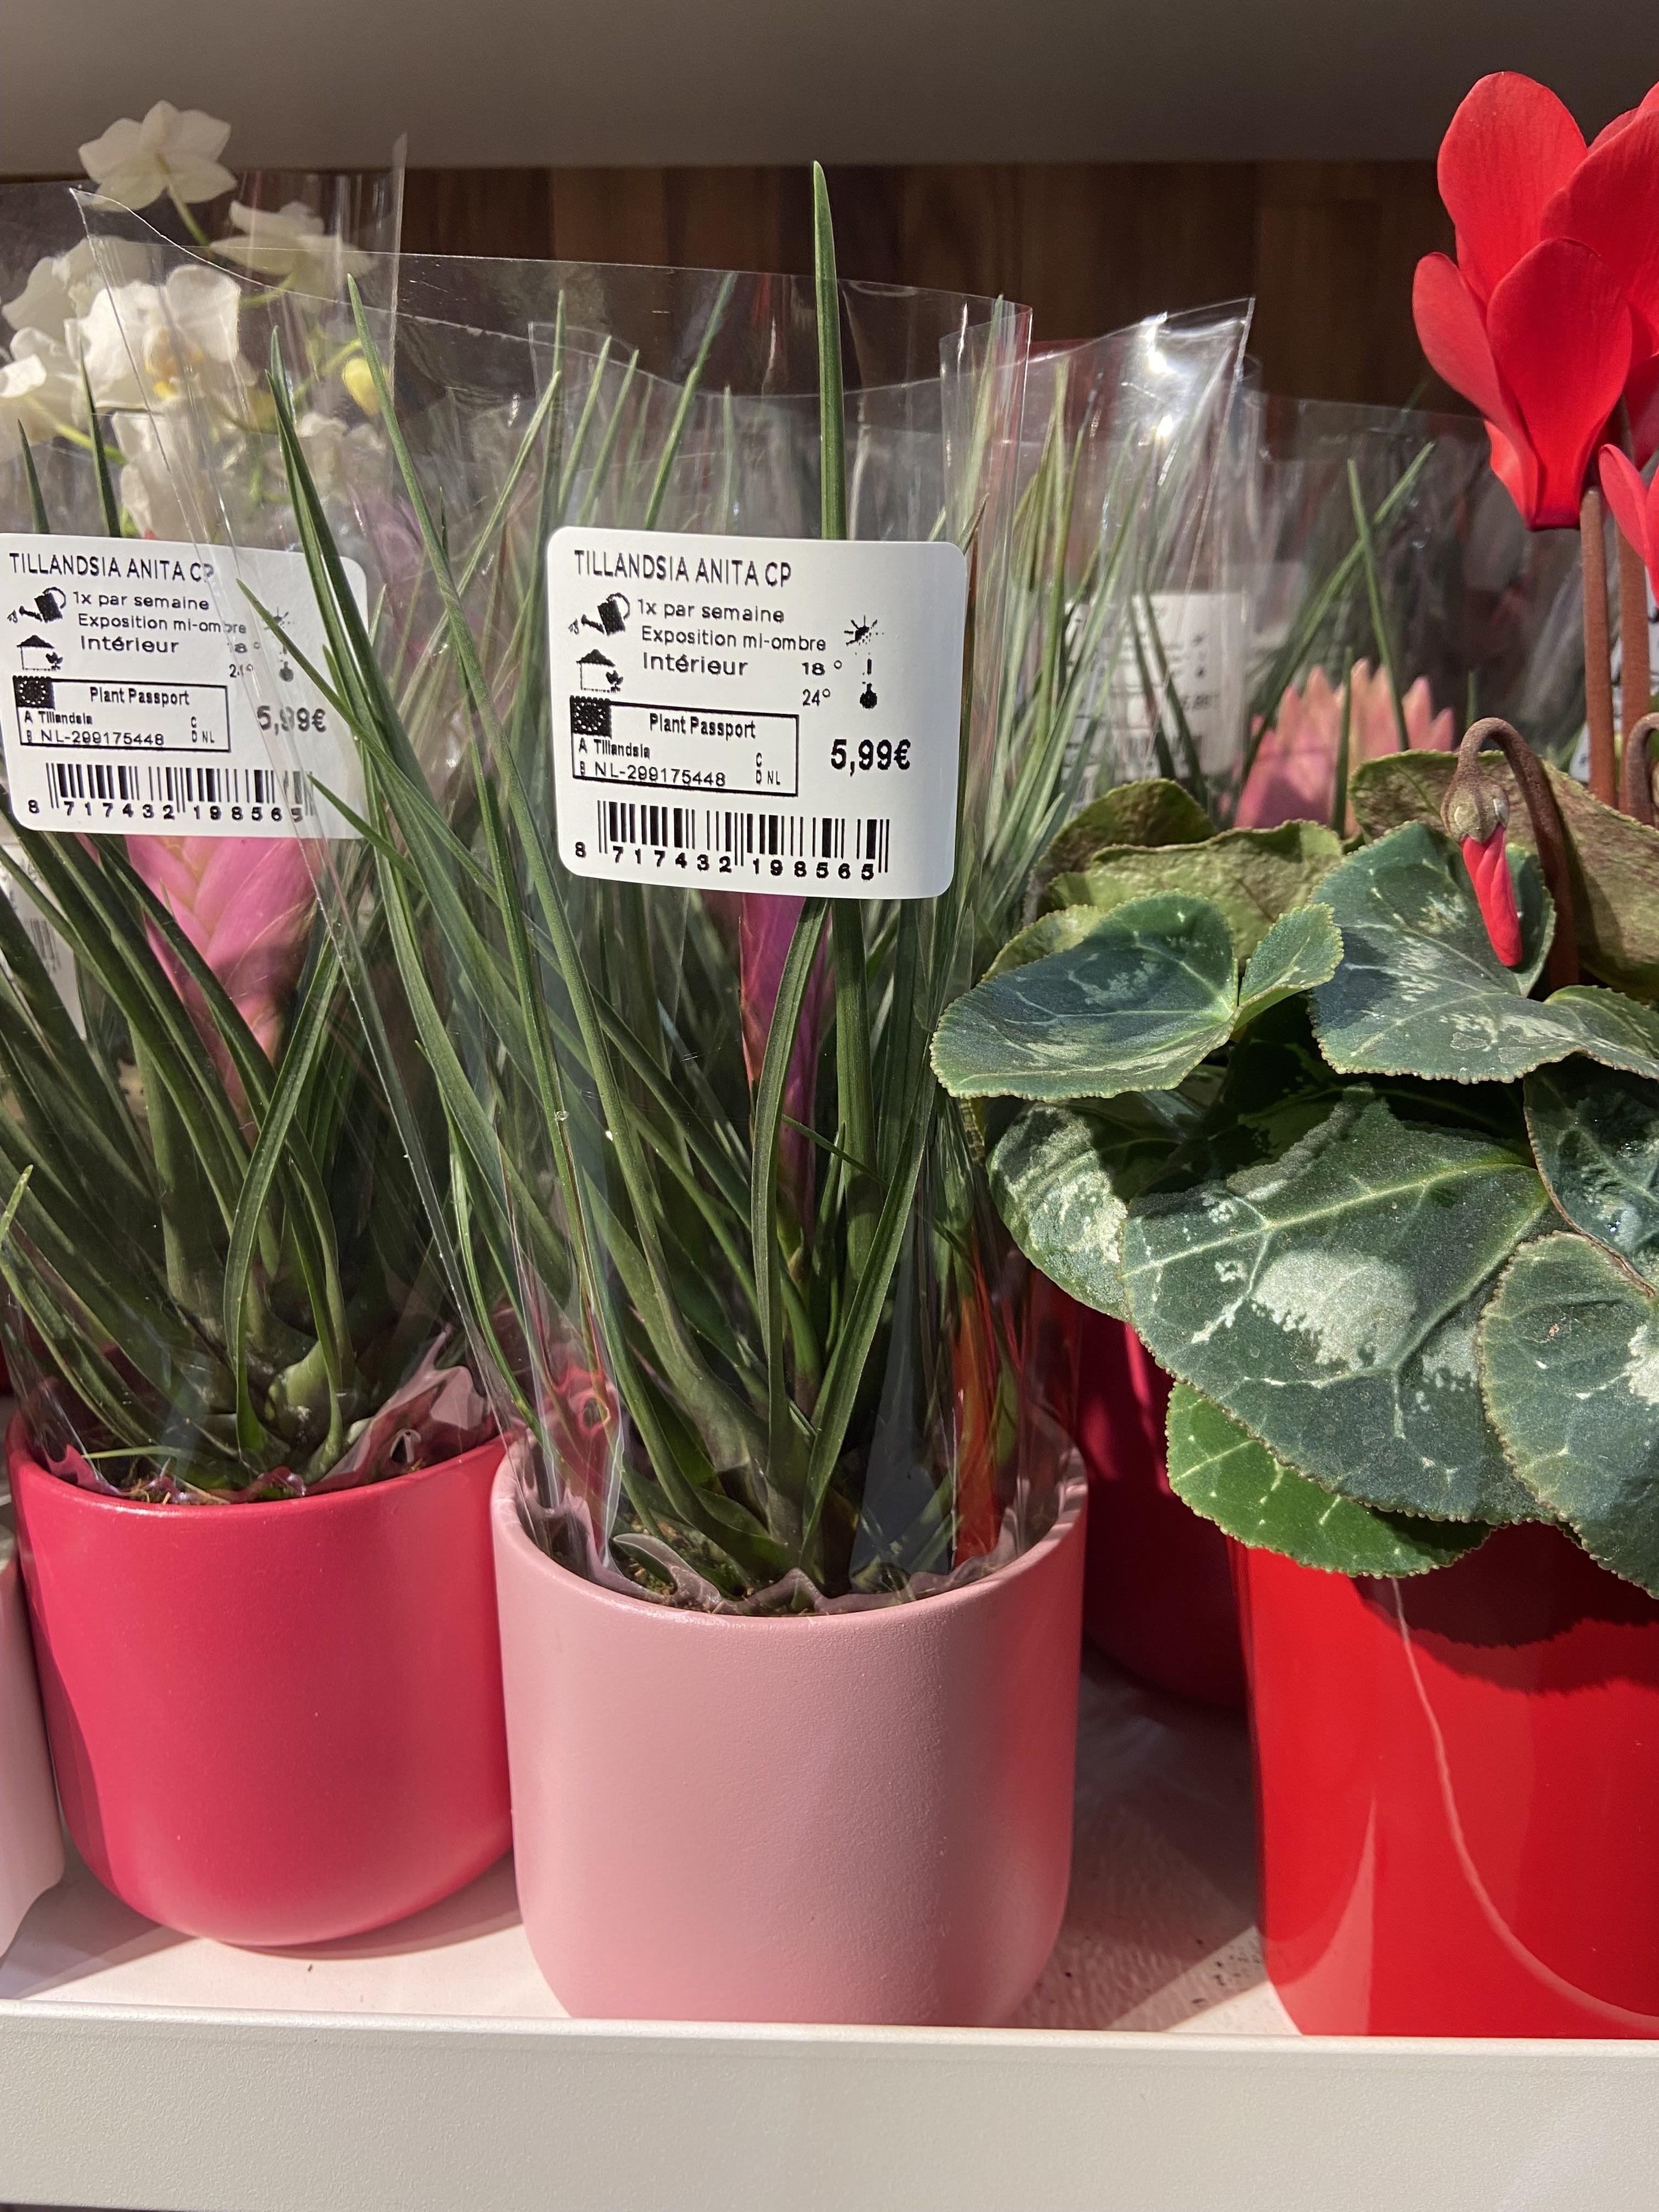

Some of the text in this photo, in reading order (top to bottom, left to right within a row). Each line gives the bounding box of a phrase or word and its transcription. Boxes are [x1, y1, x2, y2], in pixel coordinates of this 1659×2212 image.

[9, 552, 215, 583] TILLANDSIA ANITA CP
[574, 550, 792, 588] TILLANDSIA ANITA CP
[73, 591, 209, 610] 1x par semaine
[638, 599, 785, 623] 1x par semaine
[78, 613, 167, 631] Exposition
[81, 635, 179, 653] Intérieur
[642, 625, 826, 651] Exposition mi-ombre
[643, 652, 748, 676] Intérieur
[802, 662, 825, 676] 18
[89, 686, 190, 708] Plant Passport
[24, 710, 33, 724] A
[257, 706, 326, 736] 5,99€
[650, 713, 757, 742] Plant Passport
[202, 731, 215, 744] NL
[579, 737, 588, 754] A
[831, 738, 911, 777] 5,99€
[768, 770, 781, 786] NL
[28, 799, 40, 814] 8
[574, 841, 586, 858] 8
